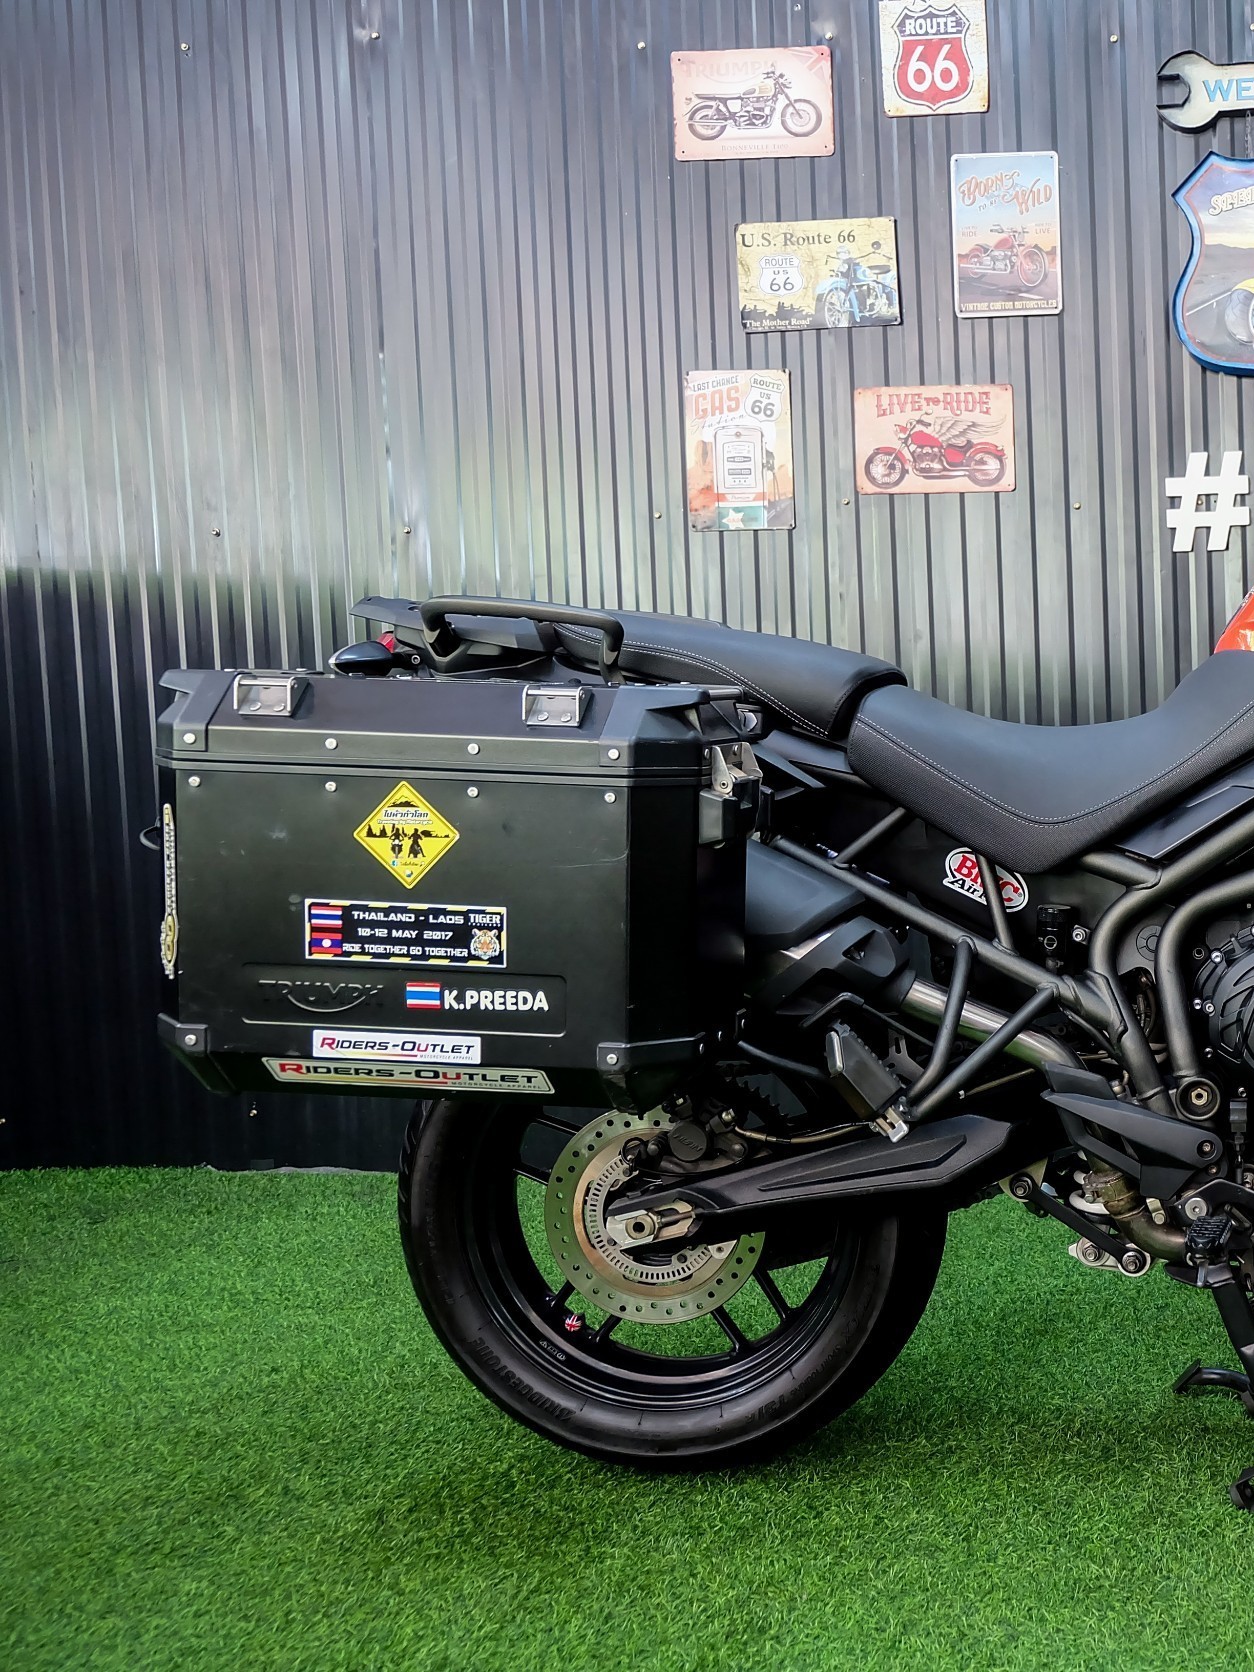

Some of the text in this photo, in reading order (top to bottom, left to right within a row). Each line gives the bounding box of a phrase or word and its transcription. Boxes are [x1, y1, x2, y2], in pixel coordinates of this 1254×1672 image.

[904, 16, 957, 35] ROUTE
[906, 43, 959, 93] 66
[1001, 178, 1053, 215] WILD
[741, 229, 856, 248] U.S. Route 66
[962, 230, 978, 238] RIDE
[1035, 227, 1051, 235] LIVE
[764, 257, 795, 267] ROUTE
[769, 276, 795, 292] 66
[762, 319, 790, 327] Mother
[693, 375, 740, 392] LAST CHANCE
[753, 378, 783, 391] ROUTE
[694, 385, 741, 420] GAS
[759, 391, 772, 400] US
[750, 399, 776, 419] 66
[876, 392, 923, 418] LIVE
[942, 391, 992, 417] RIDE
[352, 910, 415, 922] THAILAND
[429, 914, 465, 925] LAOS
[468, 912, 501, 924] TIGER
[357, 927, 454, 940] 10-12 MAY 2017
[342, 943, 469, 957] RIDE TOGETHER GO TOGETHER
[443, 988, 549, 1013] K.PREEDA
[451, 1080, 503, 1088] MOTORCYCLE
